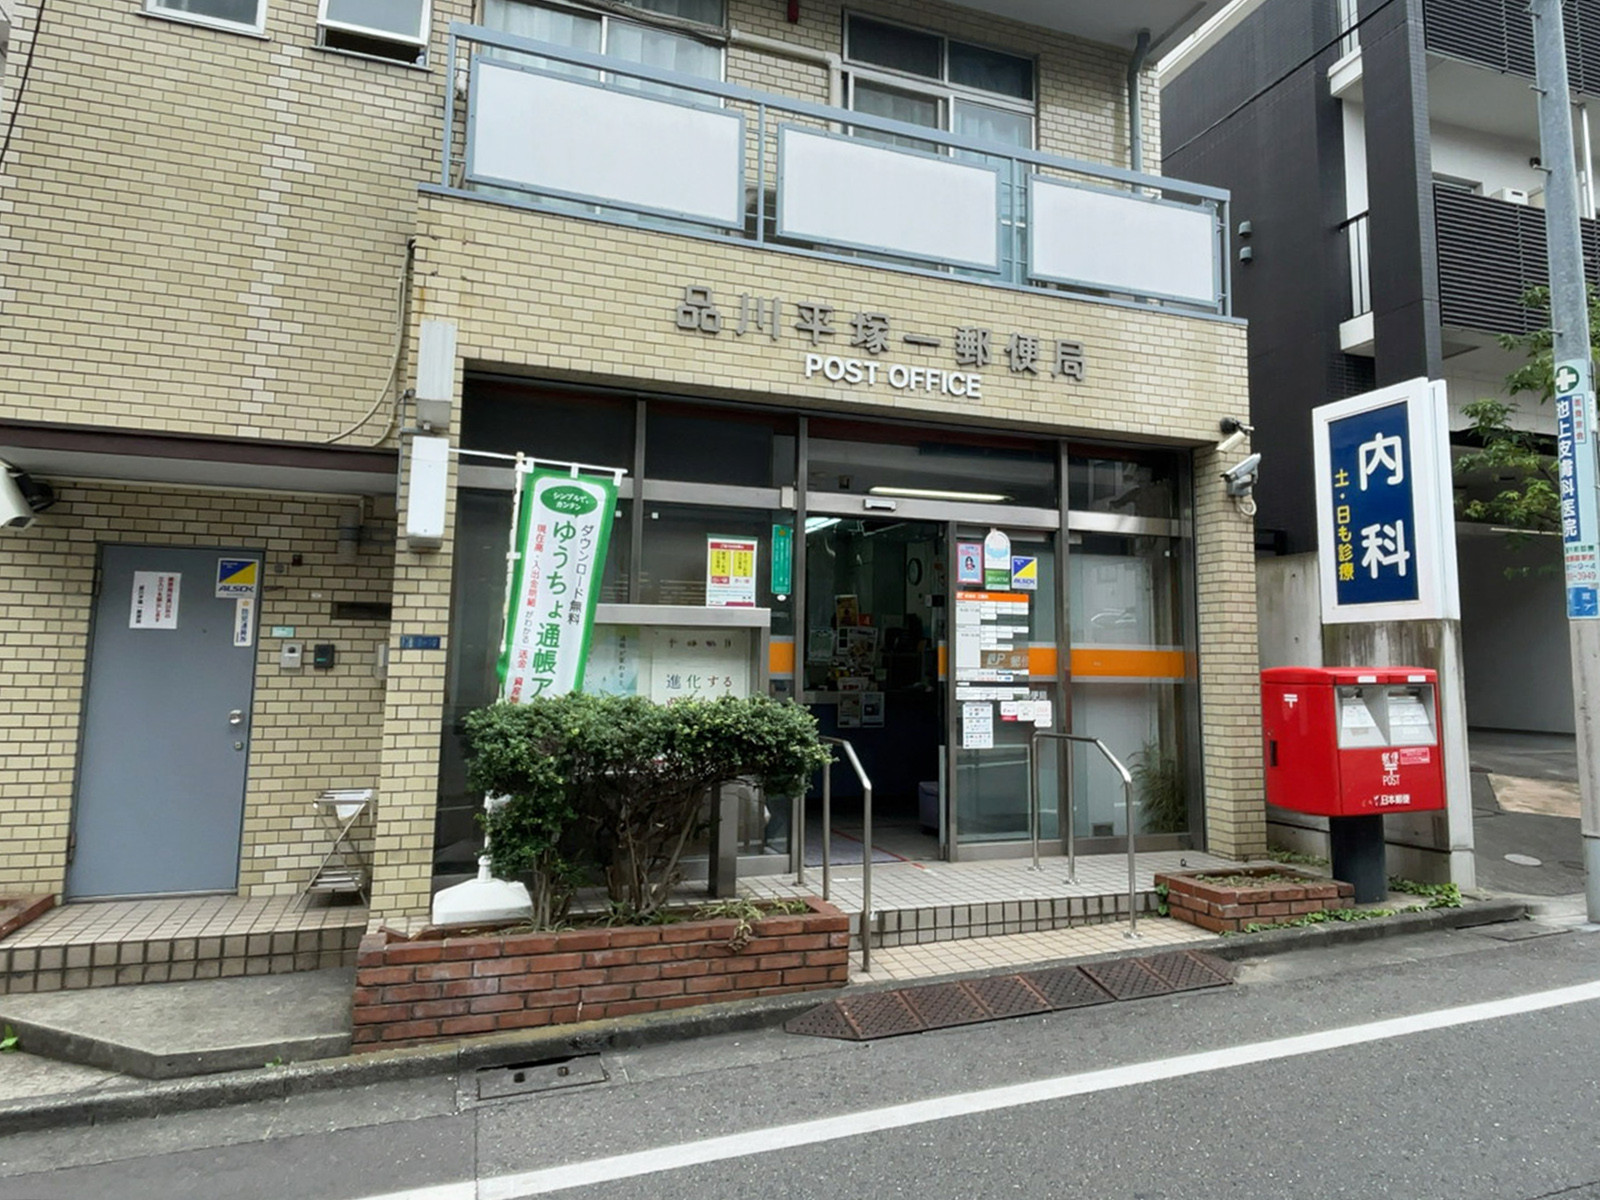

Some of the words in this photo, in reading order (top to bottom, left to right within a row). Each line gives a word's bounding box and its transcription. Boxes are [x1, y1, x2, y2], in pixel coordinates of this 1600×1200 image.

[676, 284, 1087, 381] 品川平塚一郵便局
[805, 353, 880, 388] POST
[888, 363, 982, 400] OFFICE
[1334, 469, 1355, 581] 土・日も診療
[1358, 432, 1411, 579] 内科
[567, 524, 594, 626] ダウンロード無料
[666, 674, 733, 690] 進化する
[1383, 775, 1400, 786] POST
